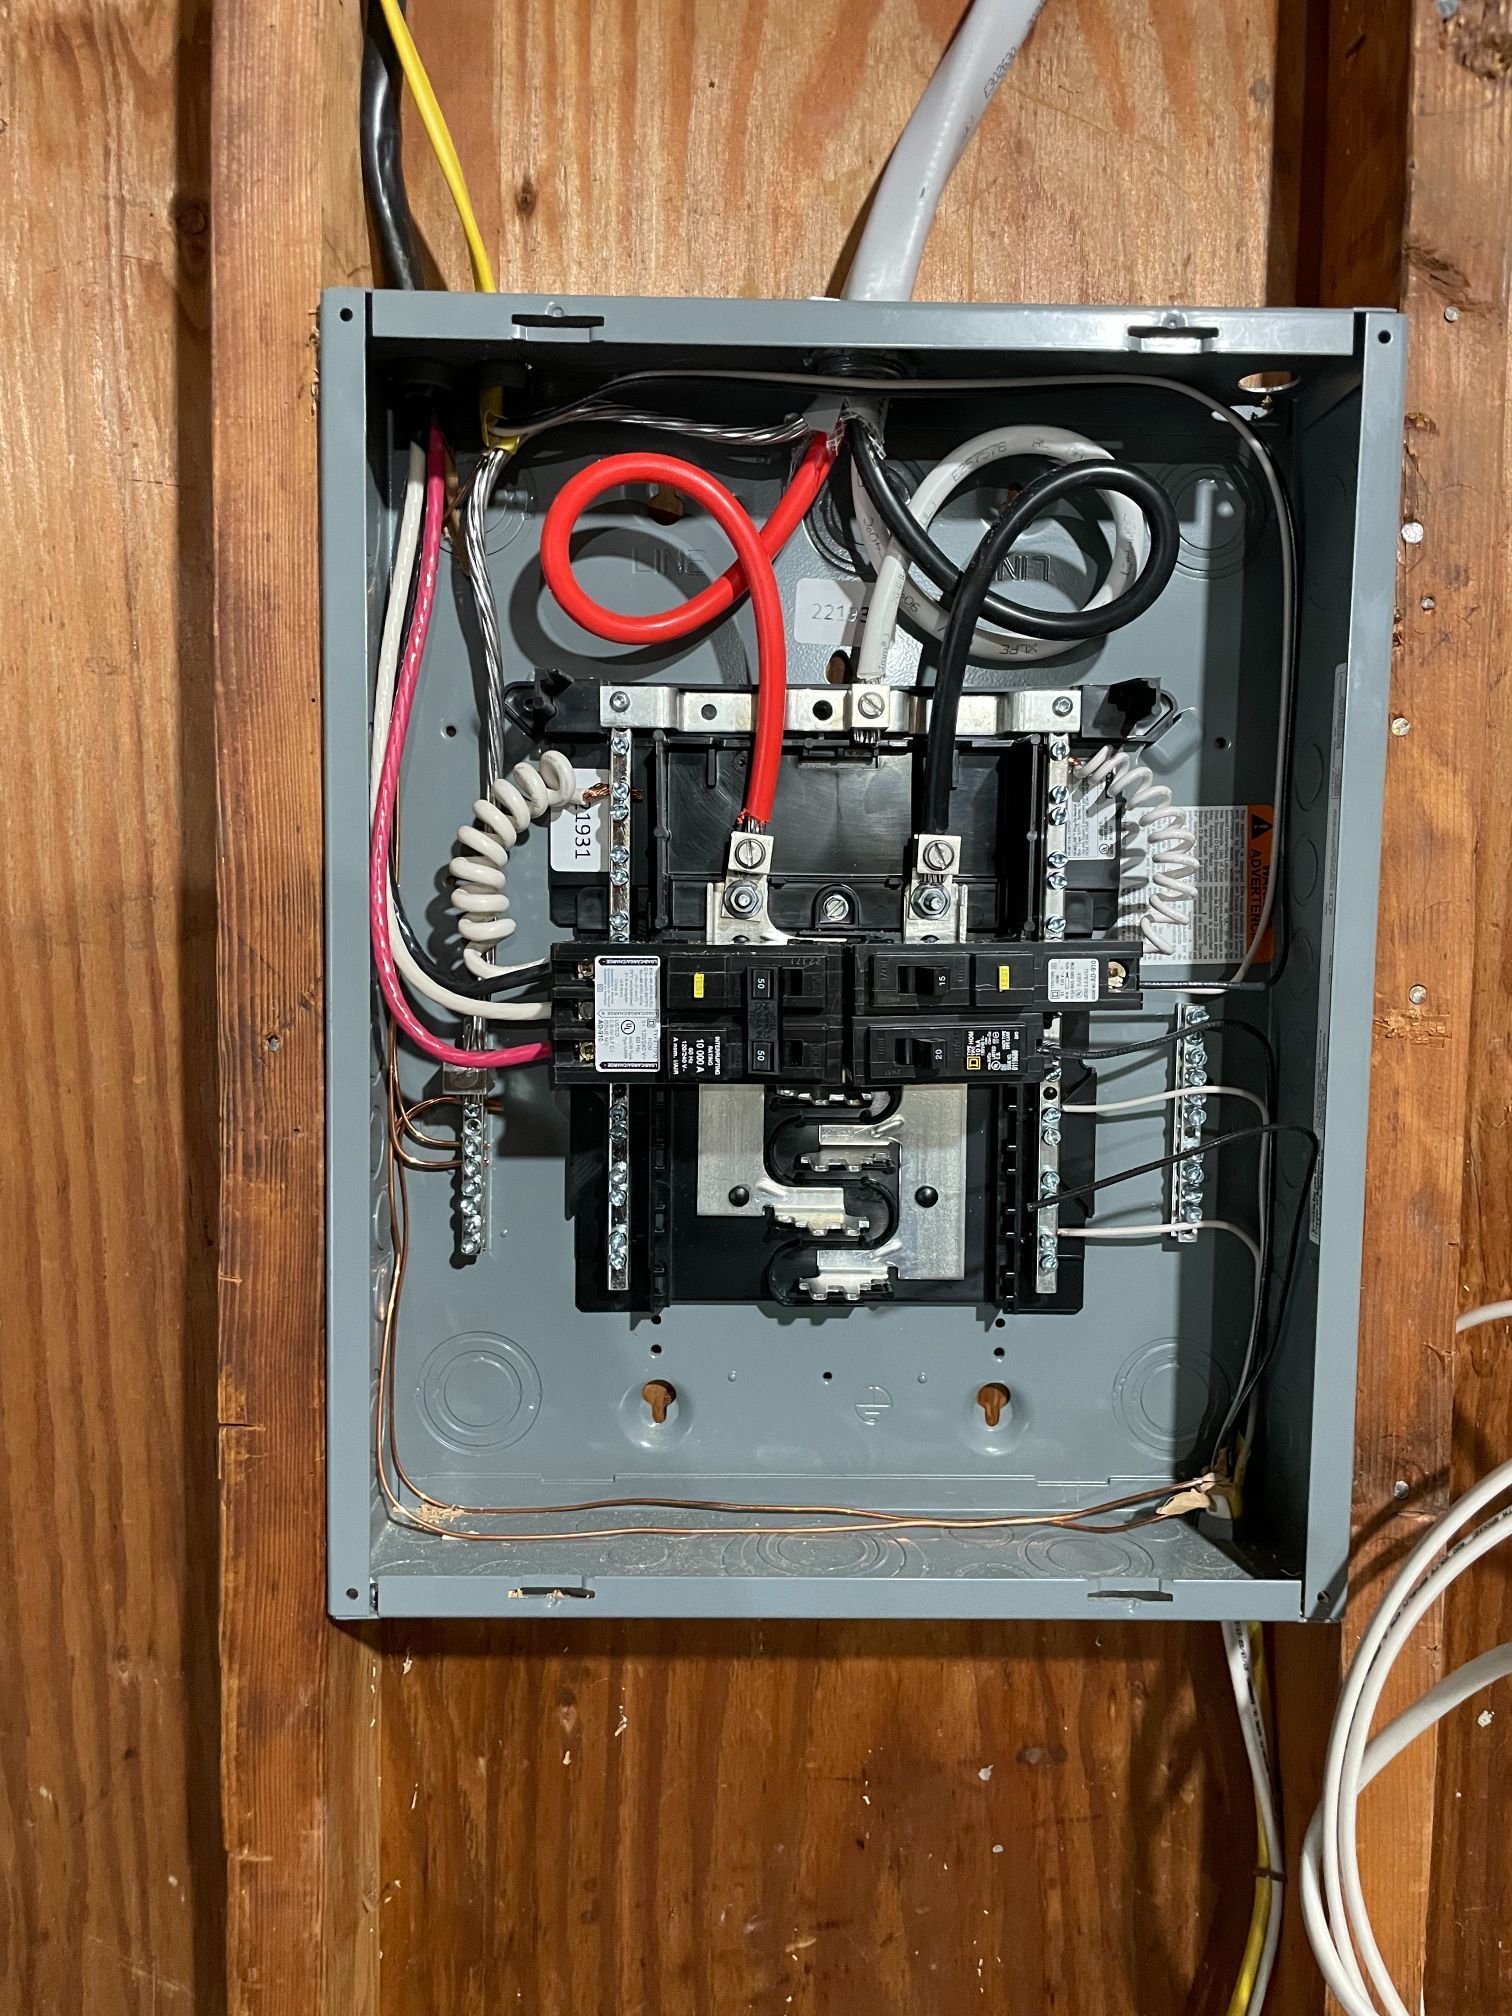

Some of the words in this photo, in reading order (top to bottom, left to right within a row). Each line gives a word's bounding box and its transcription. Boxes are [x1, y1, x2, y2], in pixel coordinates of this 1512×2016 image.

[631, 548, 706, 576] LINE
[994, 555, 1051, 582] LIN
[811, 603, 869, 624] 22193
[999, 643, 1038, 655] XLPE
[575, 801, 591, 860] 21931
[1250, 849, 1262, 947] ADVERTENCI
[757, 978, 765, 989] 50
[938, 975, 946, 986] 15
[757, 1050, 765, 1061] 50
[935, 1049, 943, 1060] 20
